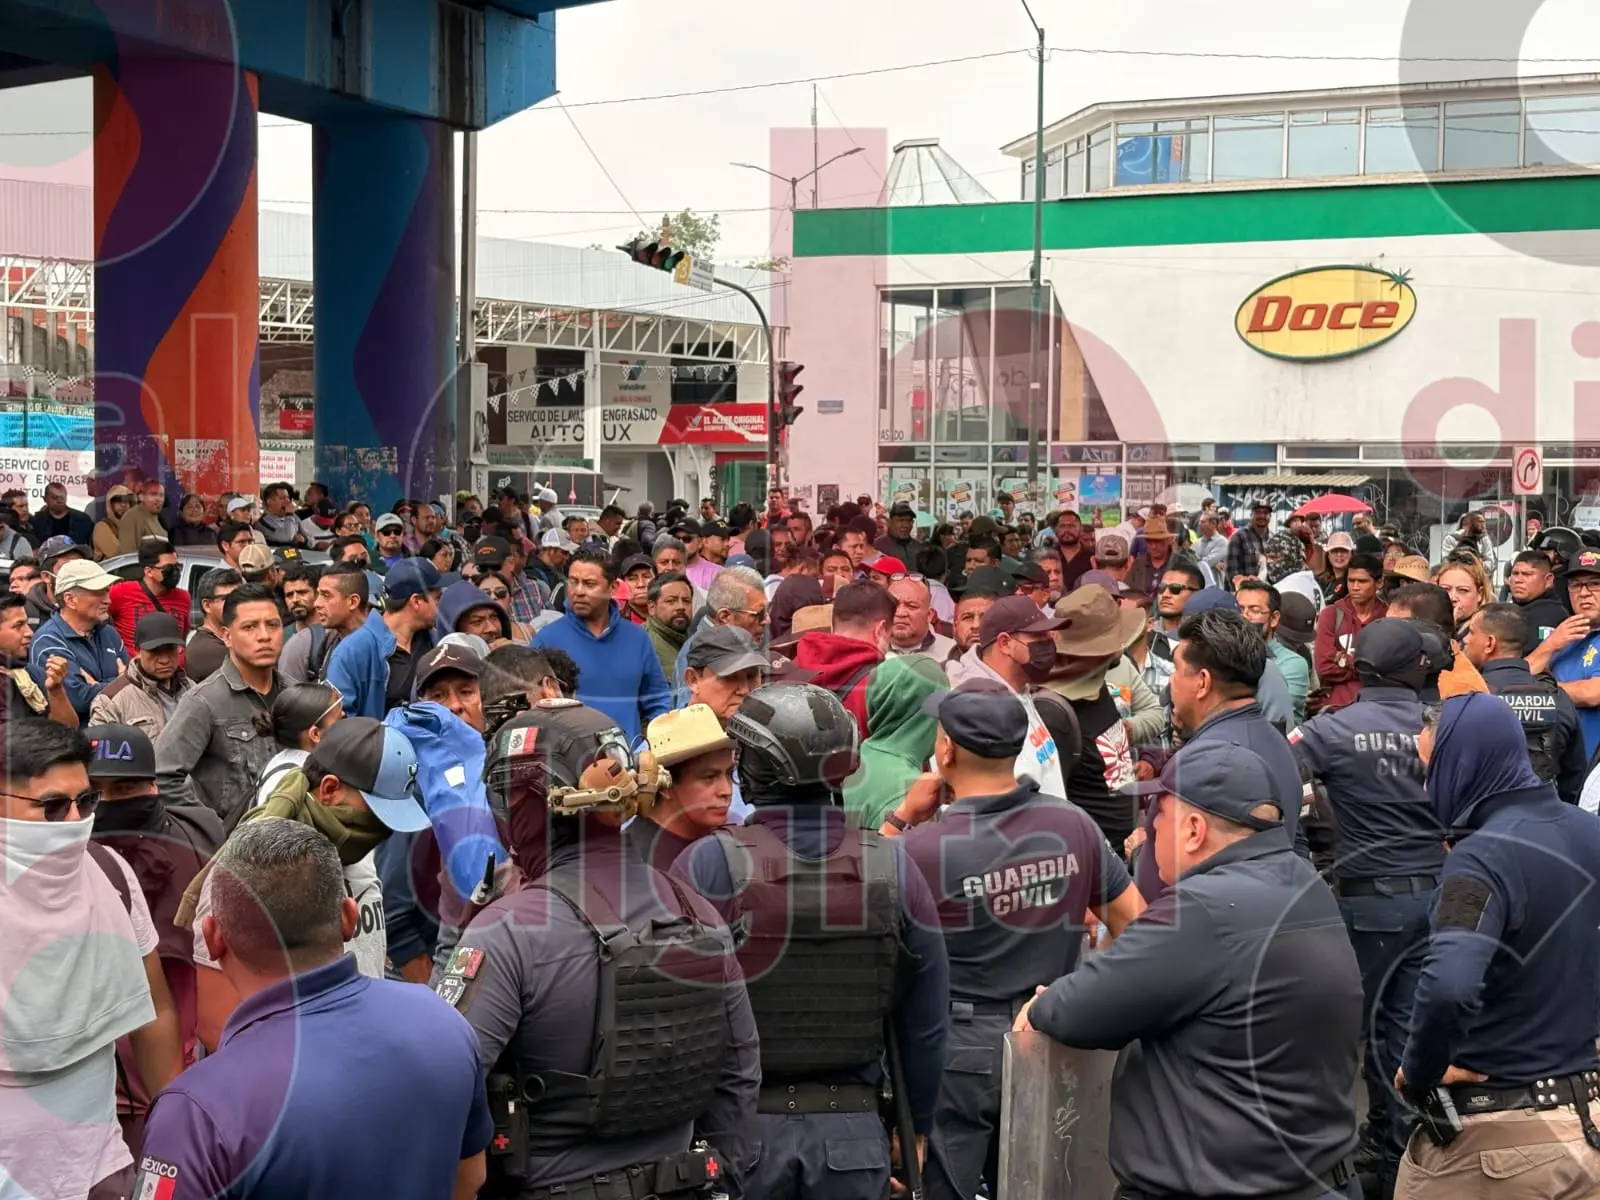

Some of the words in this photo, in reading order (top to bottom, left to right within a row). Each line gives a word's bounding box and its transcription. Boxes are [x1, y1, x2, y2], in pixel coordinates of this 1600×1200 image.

[1246, 295, 1400, 333] Doce
[508, 410, 545, 423] SERVICIO
[550, 410, 560, 422] DE
[603, 408, 658, 421] ENGRASADO
[733, 416, 765, 425] ORIGINAL
[0, 459, 50, 471] SERVICIO
[55, 460, 70, 472] DE
[19, 474, 28, 483] Y
[1514, 709, 1544, 721] IVIL
[963, 853, 1080, 898] GUARDIA
[993, 884, 1059, 916] CIVIL
